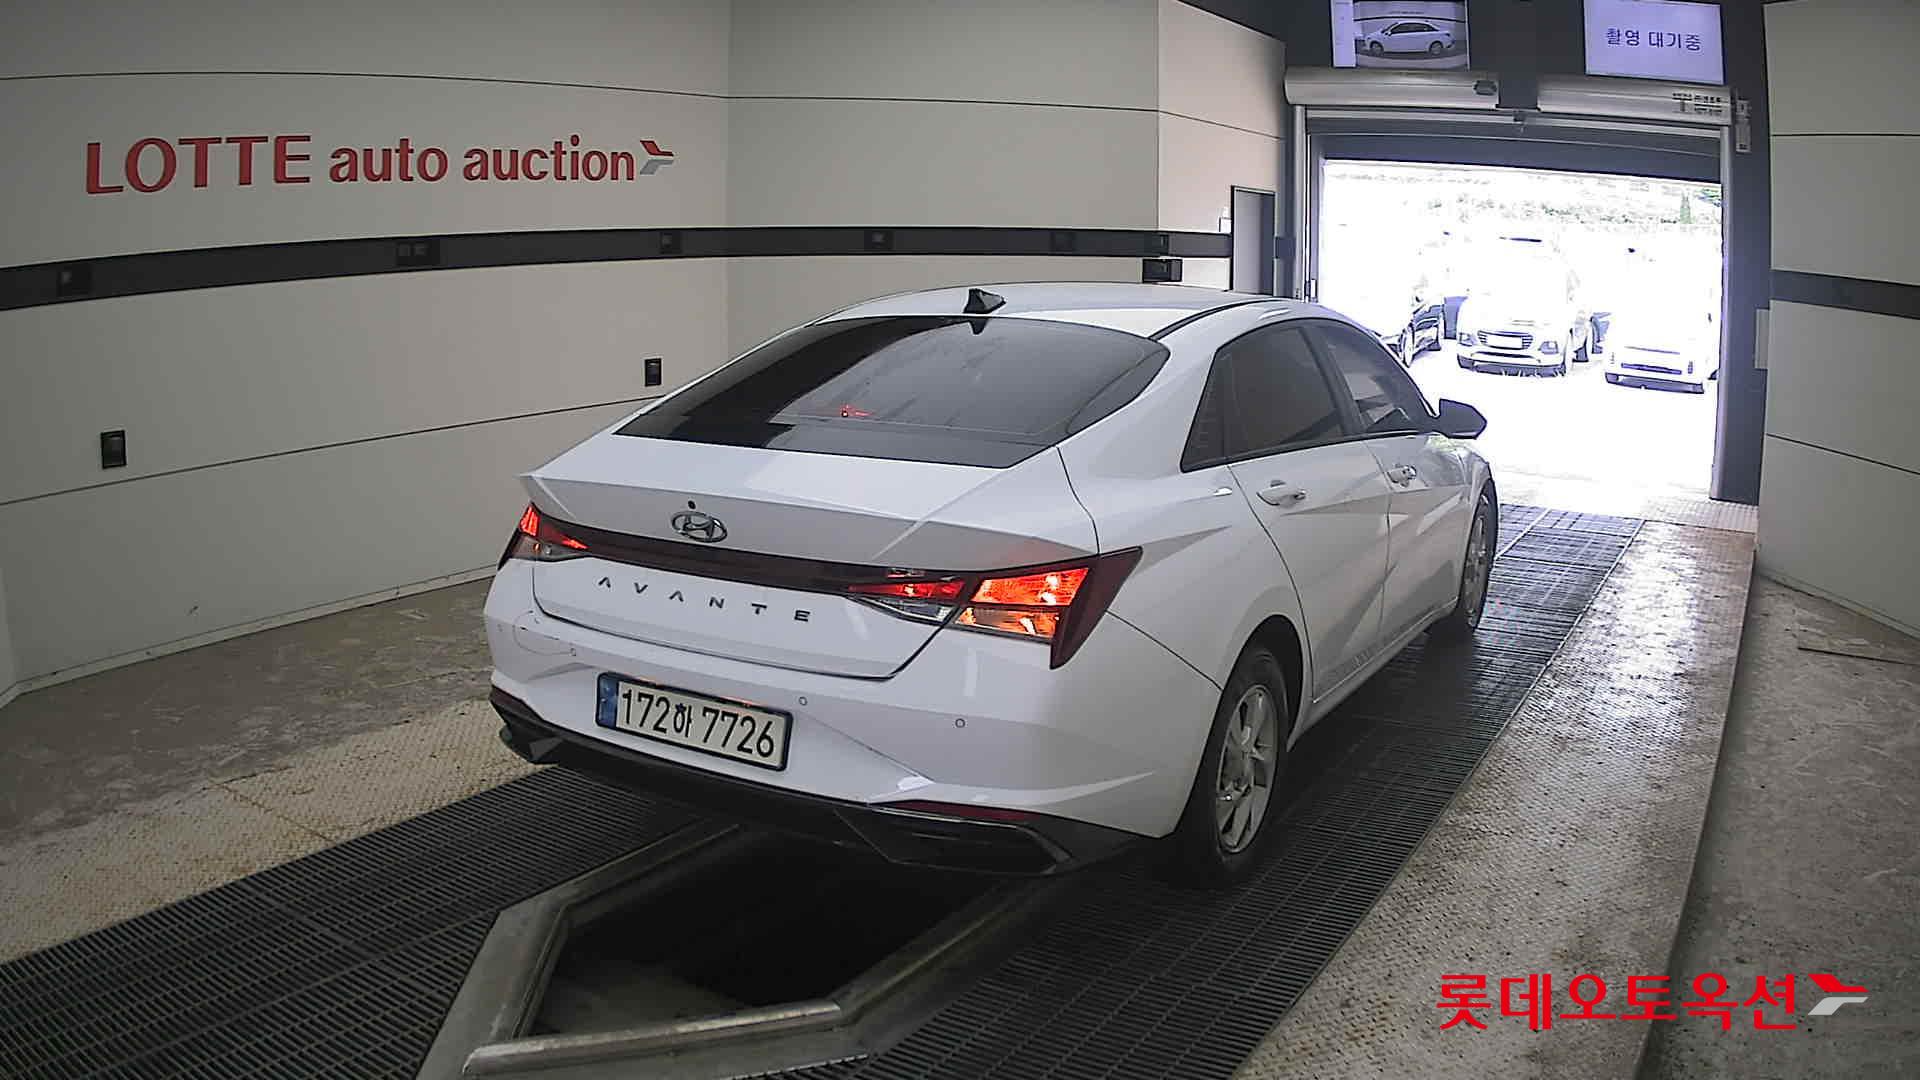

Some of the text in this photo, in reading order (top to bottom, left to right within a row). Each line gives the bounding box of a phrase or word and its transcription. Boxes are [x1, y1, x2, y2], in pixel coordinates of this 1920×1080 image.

[1605, 28, 1702, 52] 촬영 대기중
[87, 135, 636, 194] LOTTE auto auction
[597, 576, 812, 623] AVANTE
[622, 689, 775, 758] 172하 7726
